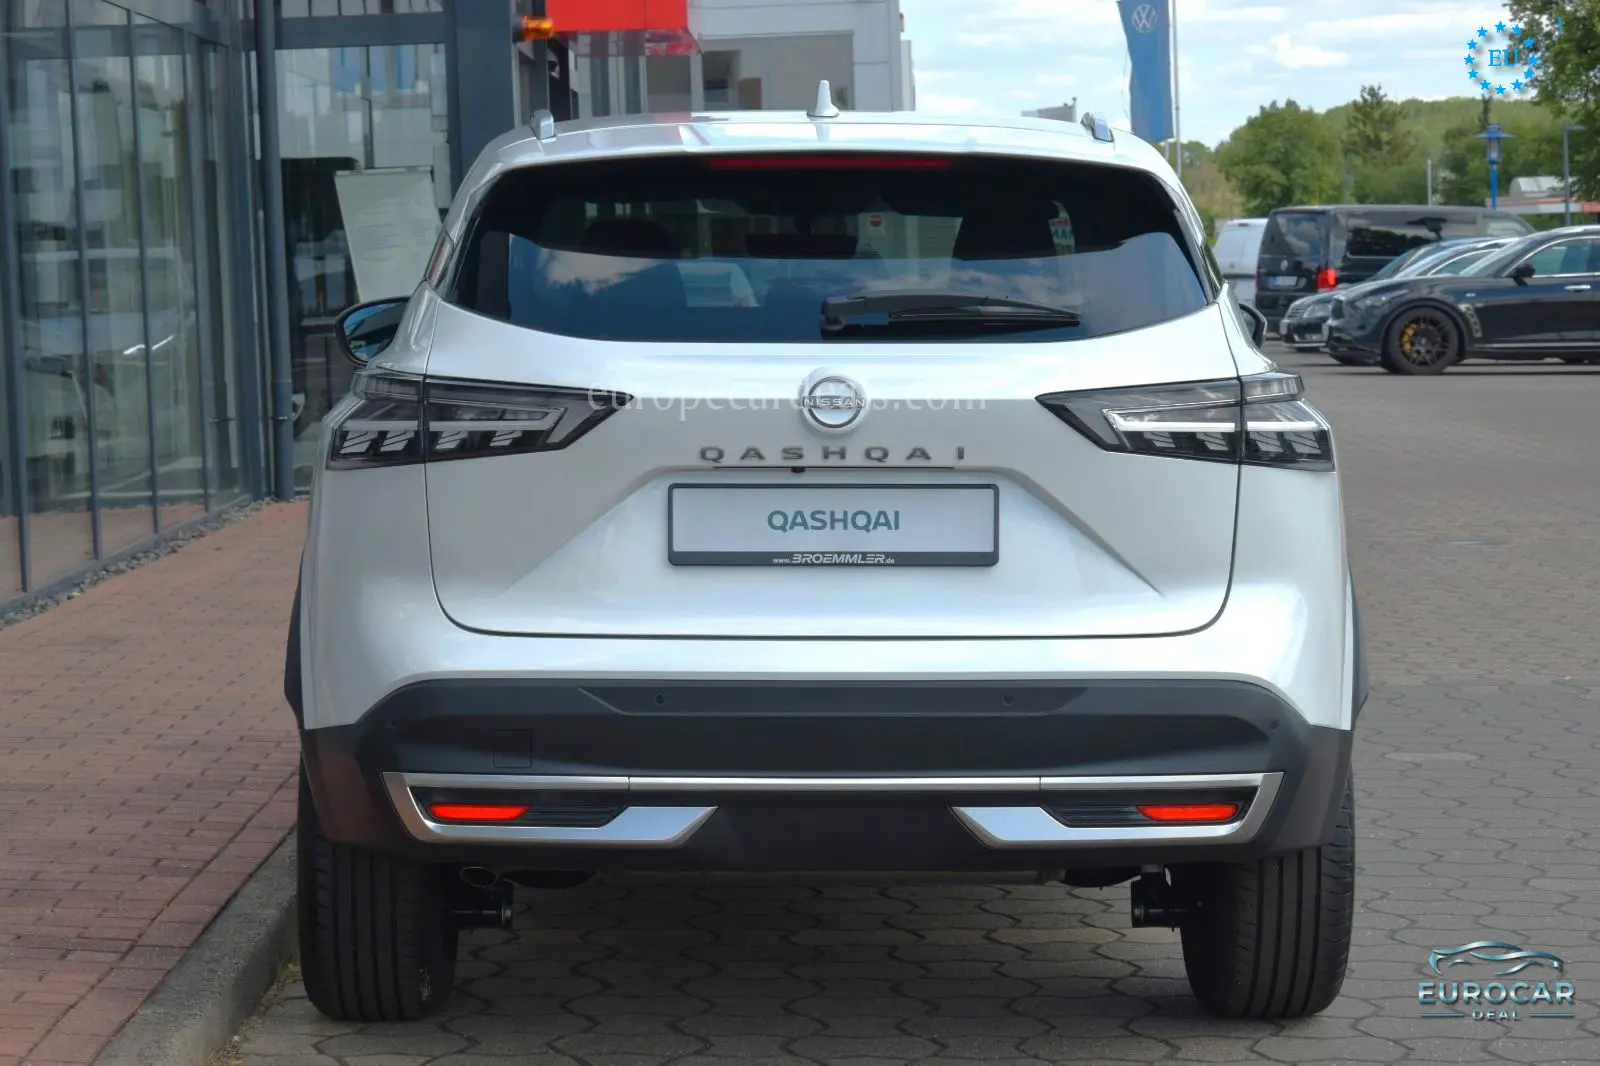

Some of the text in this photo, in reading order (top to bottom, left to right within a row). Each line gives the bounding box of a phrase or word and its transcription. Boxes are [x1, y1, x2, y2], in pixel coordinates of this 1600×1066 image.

[803, 397, 865, 407] NISSAN
[699, 445, 966, 463] QASHQAI
[767, 509, 900, 533] QASHQAI
